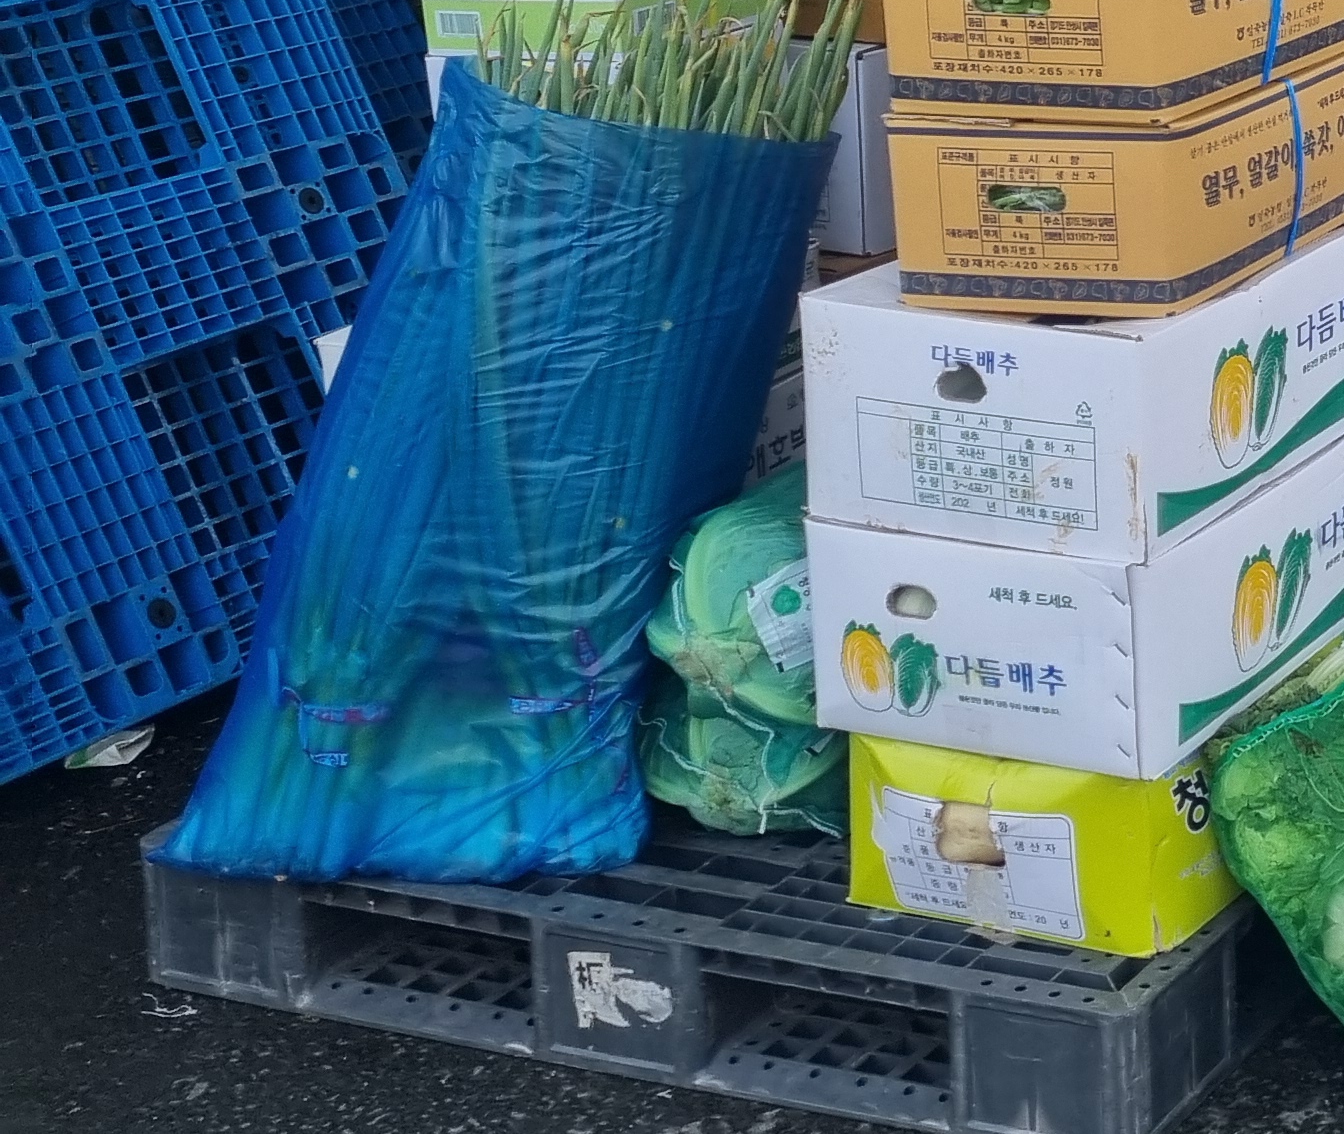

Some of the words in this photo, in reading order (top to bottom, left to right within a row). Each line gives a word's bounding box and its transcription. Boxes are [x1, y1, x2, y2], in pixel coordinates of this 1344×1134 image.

[1202, 165, 1244, 208] 열무,
[930, 344, 1019, 377] 다듬배추
[960, 430, 979, 442] 배추
[956, 447, 985, 460] 국내산
[1008, 470, 1030, 483] 주소
[1016, 506, 1036, 518] 세척
[1038, 508, 1048, 520] 후
[988, 586, 1014, 604] 세척
[1018, 589, 1031, 606] 후
[1034, 592, 1078, 611] 드세요.
[943, 654, 1067, 696] 다듬배추
